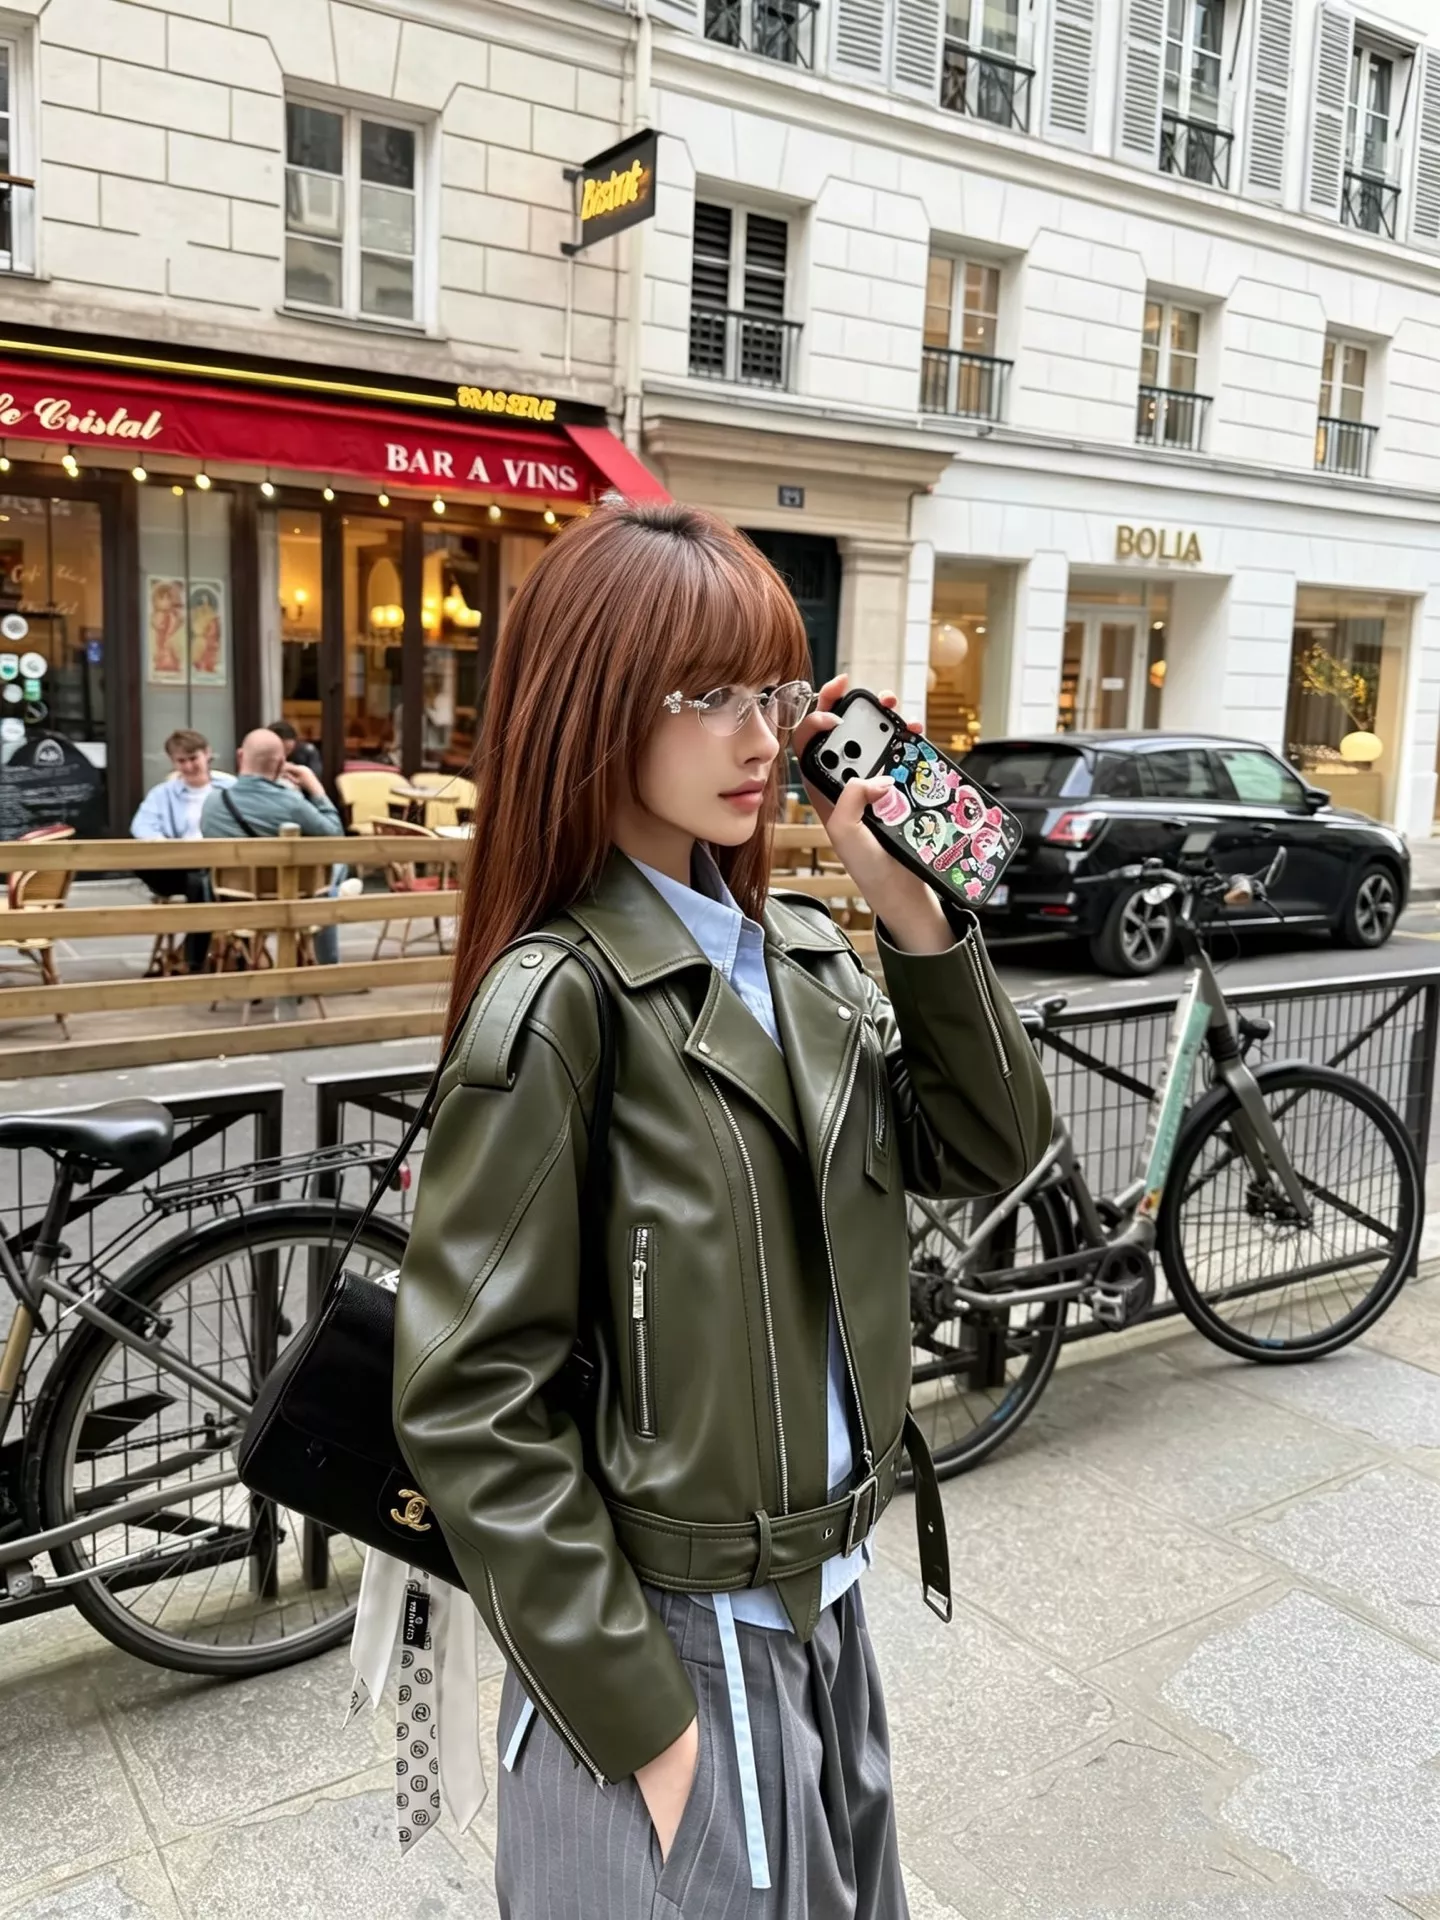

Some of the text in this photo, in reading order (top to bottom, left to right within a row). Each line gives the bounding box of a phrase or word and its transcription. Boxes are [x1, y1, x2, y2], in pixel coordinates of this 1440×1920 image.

[34, 397, 163, 440] Cristal
[384, 443, 456, 478] BAR
[503, 458, 579, 492] VINS
[1115, 525, 1202, 562] BOLIA
